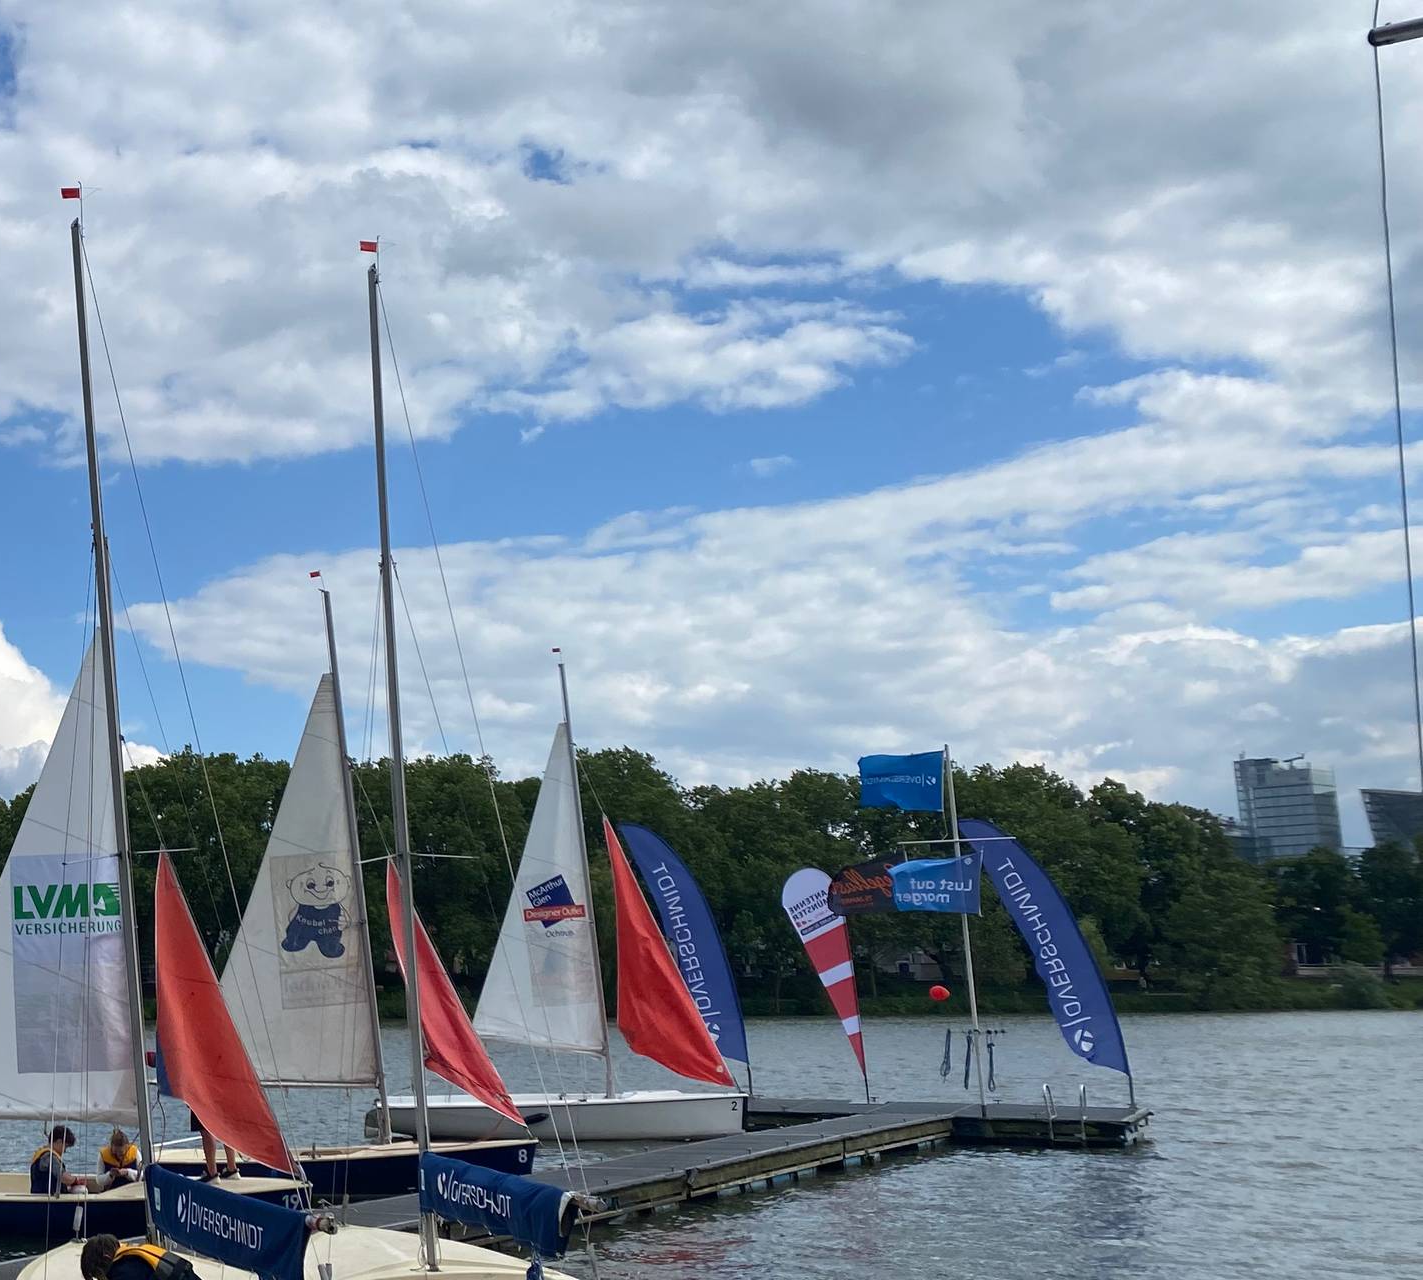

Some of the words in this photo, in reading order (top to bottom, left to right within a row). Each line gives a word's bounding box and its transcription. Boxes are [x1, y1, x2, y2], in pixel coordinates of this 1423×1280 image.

[528, 878, 564, 900] McArthur
[13, 883, 90, 920] LVM
[532, 894, 552, 907] Glen
[15, 920, 122, 936] VERSICHERUNG
[731, 1101, 738, 1111] 2
[518, 1149, 528, 1163] 8
[282, 1194, 299, 1210] 19
[190, 1202, 264, 1251] OVERSCHMIDT
